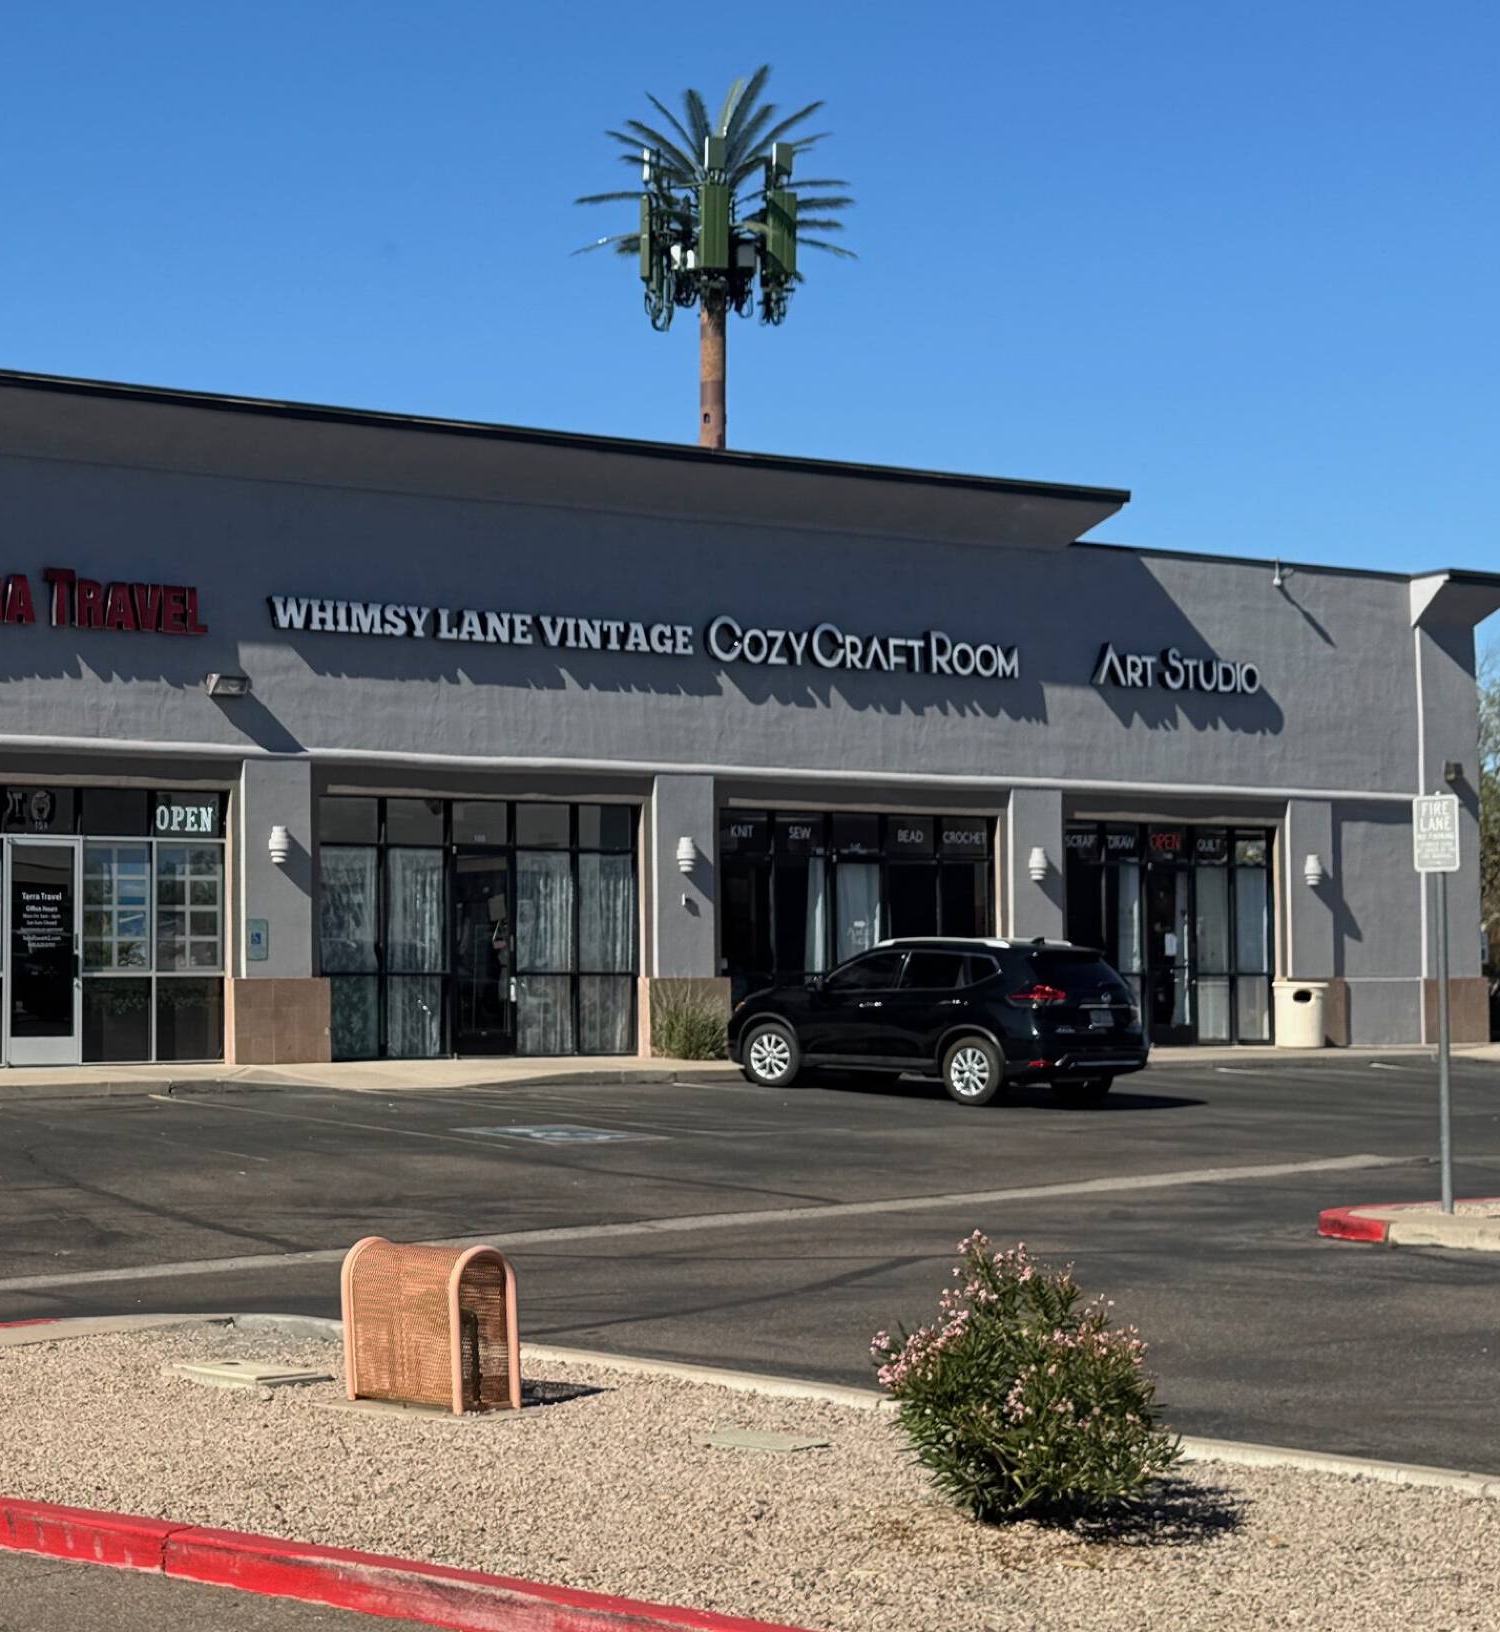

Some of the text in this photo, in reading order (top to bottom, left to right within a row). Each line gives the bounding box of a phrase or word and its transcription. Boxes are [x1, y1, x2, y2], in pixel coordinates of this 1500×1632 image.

[43, 567, 209, 634] TRAVEL
[268, 596, 694, 655] WHIMSY LANE VINTAGE
[1094, 642, 1261, 694] ART STUDIO
[1421, 801, 1450, 816] FIRE
[156, 805, 213, 832] OPEN
[1420, 816, 1452, 833] LANE
[729, 824, 754, 838] KNIT
[788, 826, 811, 840] SEW
[897, 829, 924, 844] BEAD
[942, 831, 987, 845] CROCHET
[1106, 835, 1136, 848] DRAW
[1150, 834, 1181, 850] OPEN
[22, 891, 62, 900] Terra Travel
